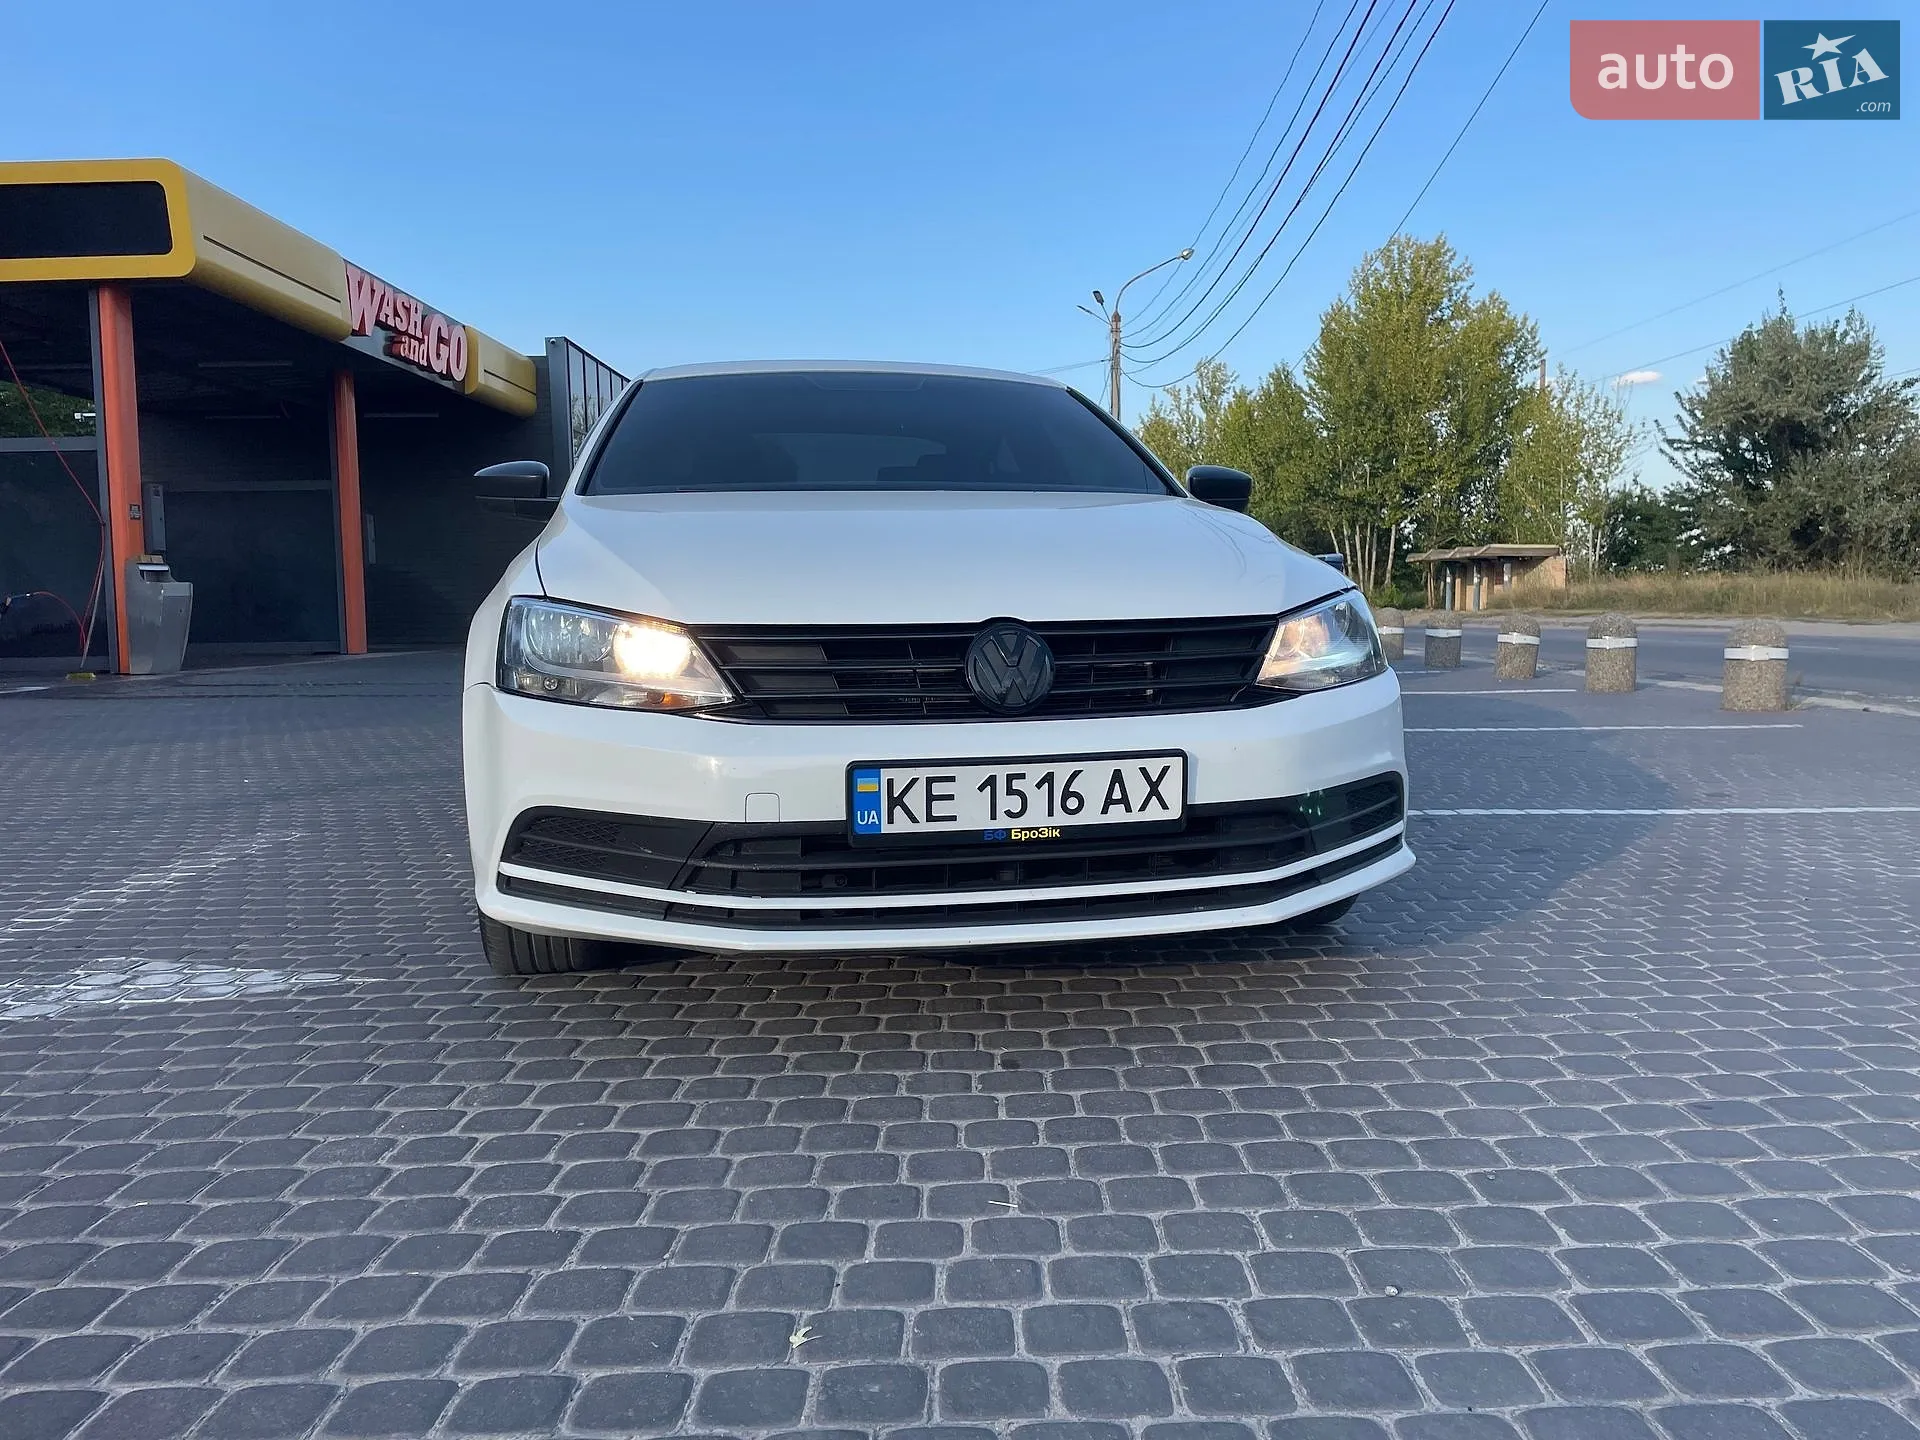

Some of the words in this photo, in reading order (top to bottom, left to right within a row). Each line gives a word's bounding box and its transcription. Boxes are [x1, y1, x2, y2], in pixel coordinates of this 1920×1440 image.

[346, 263, 424, 338] WASH
[400, 335, 429, 367] and
[428, 313, 468, 382] GO
[857, 810, 879, 825] UA
[886, 775, 957, 825] KE
[977, 769, 1085, 821] 1516
[1100, 765, 1171, 815] AX
